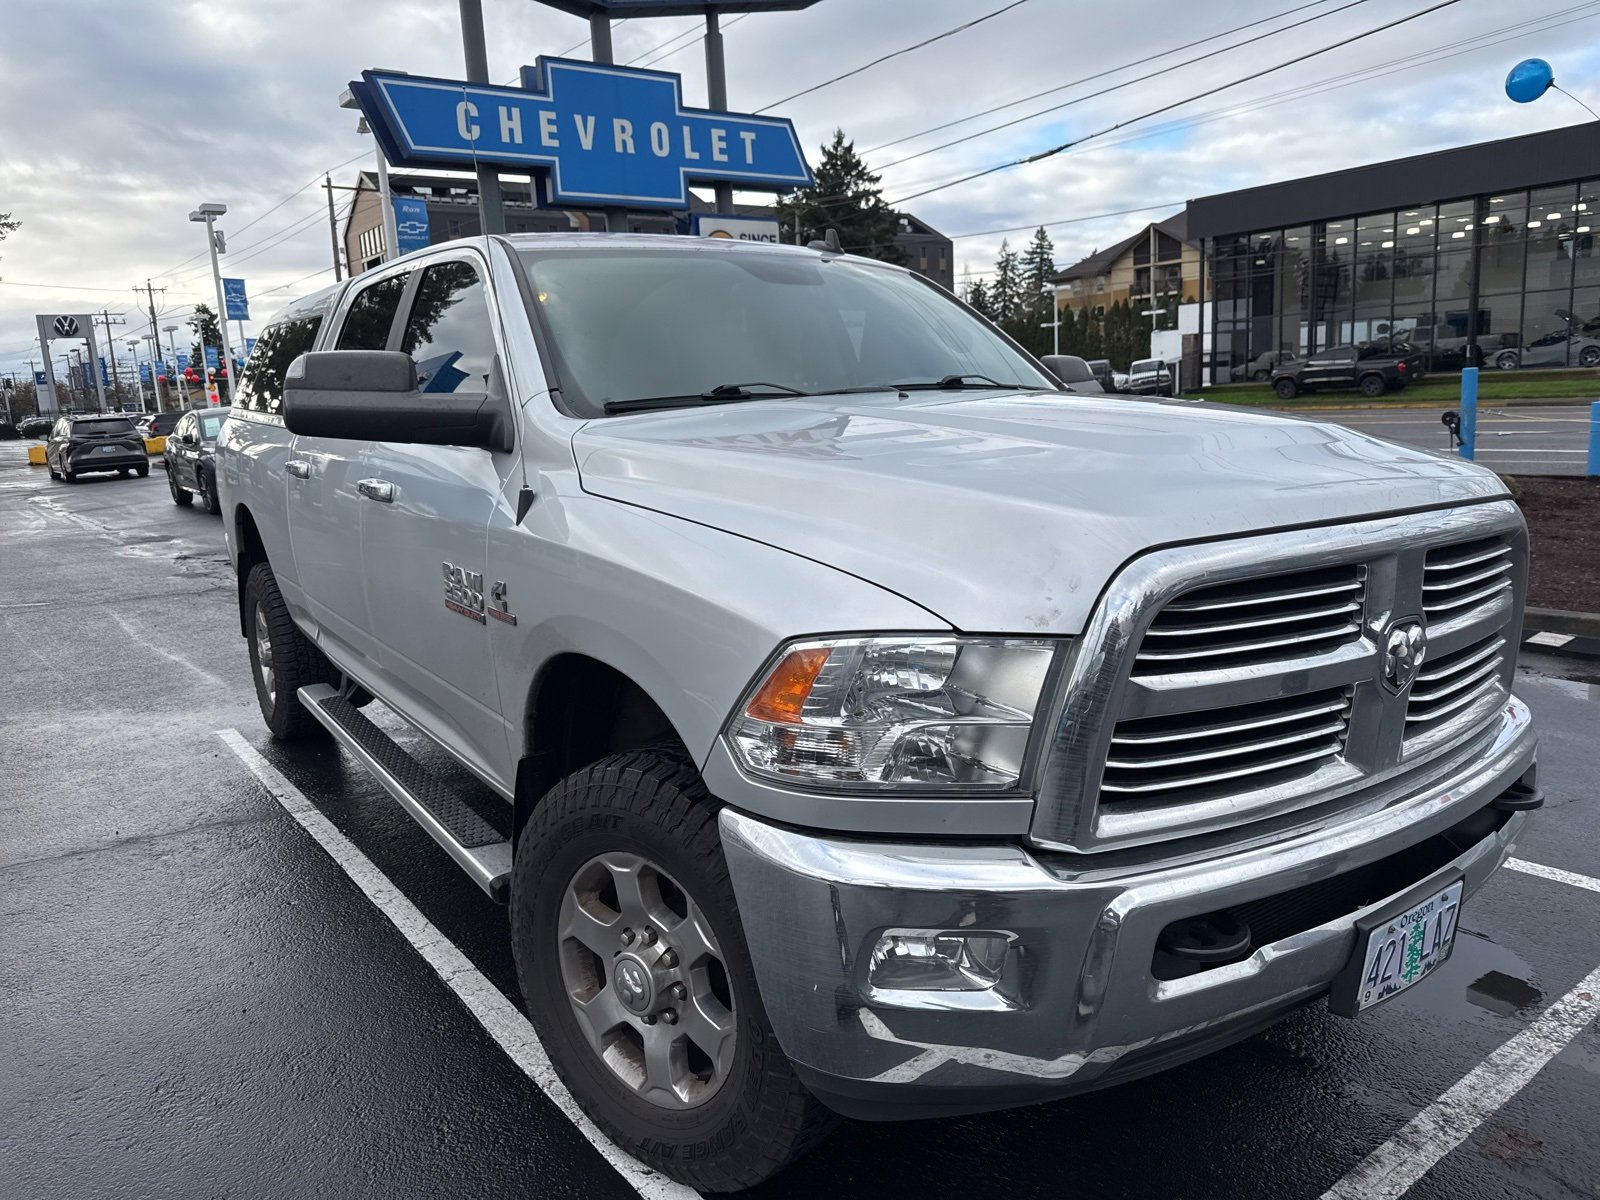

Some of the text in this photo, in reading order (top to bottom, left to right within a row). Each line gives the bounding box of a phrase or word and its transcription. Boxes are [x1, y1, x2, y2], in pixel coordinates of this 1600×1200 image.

[455, 100, 757, 165] CHEVROLET
[442, 561, 483, 594] RAM
[1400, 901, 1434, 928] Oregon
[1366, 930, 1407, 989] 421
[1364, 990, 1371, 1002] 9
